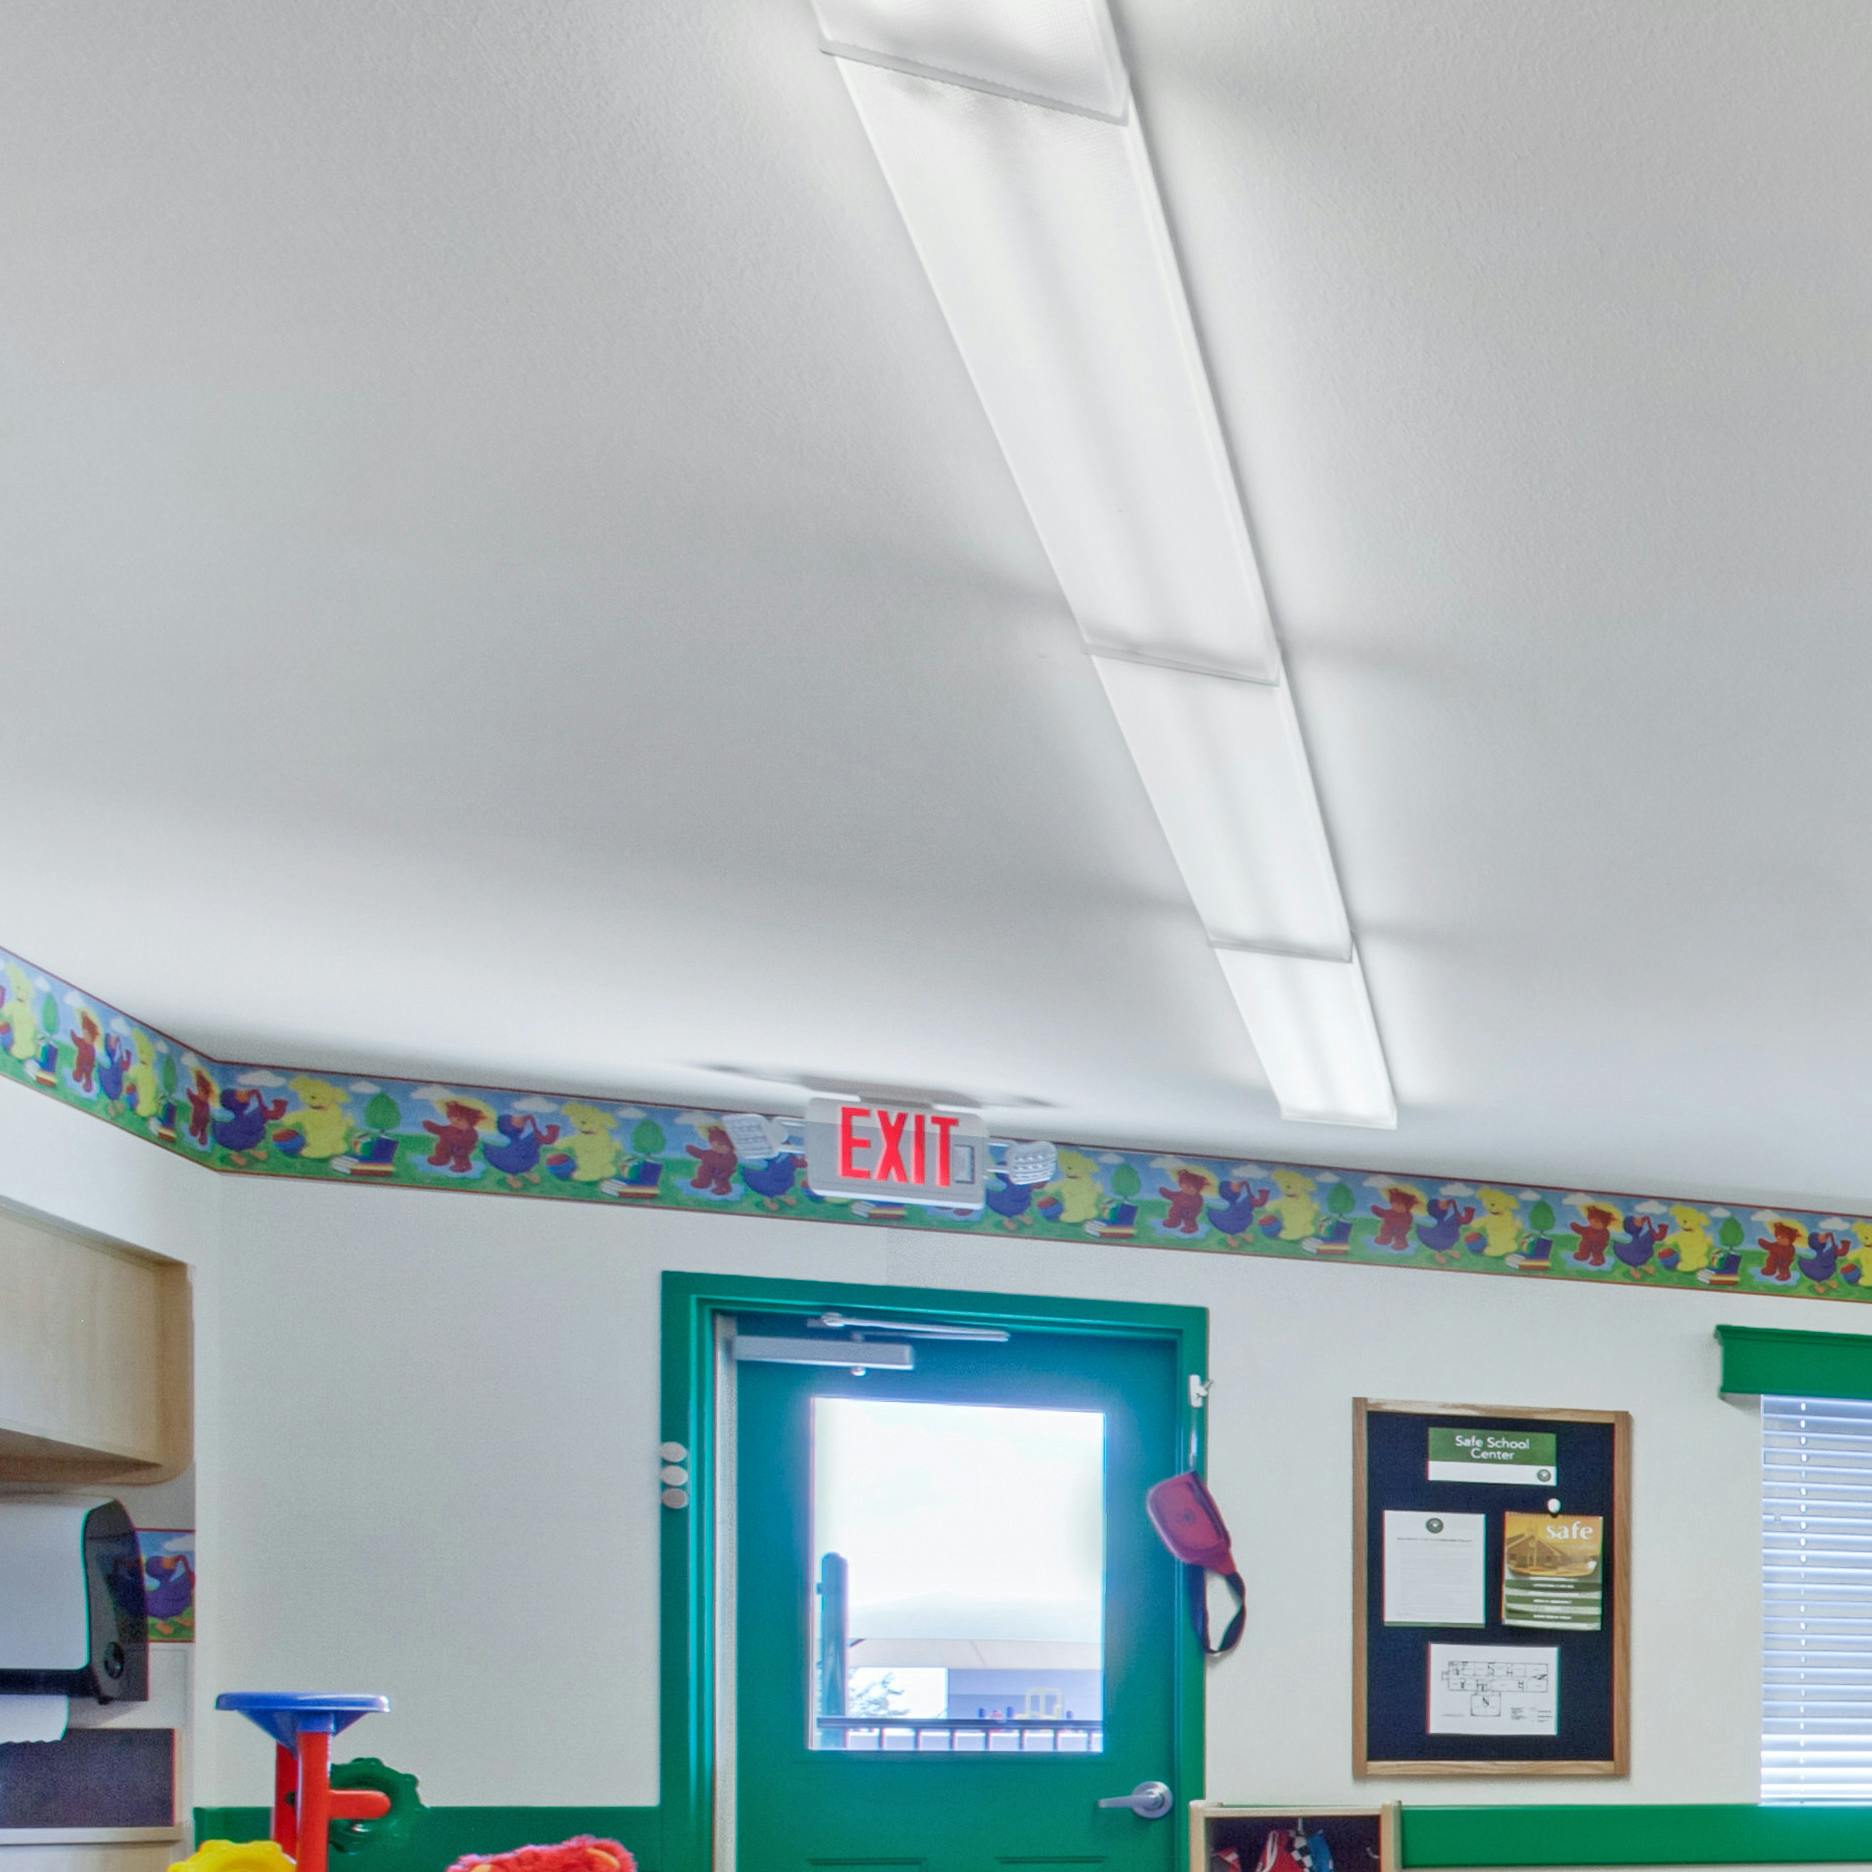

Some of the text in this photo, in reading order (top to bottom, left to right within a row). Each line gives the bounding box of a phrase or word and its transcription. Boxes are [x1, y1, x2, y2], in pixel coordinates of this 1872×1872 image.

[838, 1106, 960, 1188] EXIT
[1455, 1435, 1531, 1450] Safe School
[1470, 1447, 1516, 1461] Center
